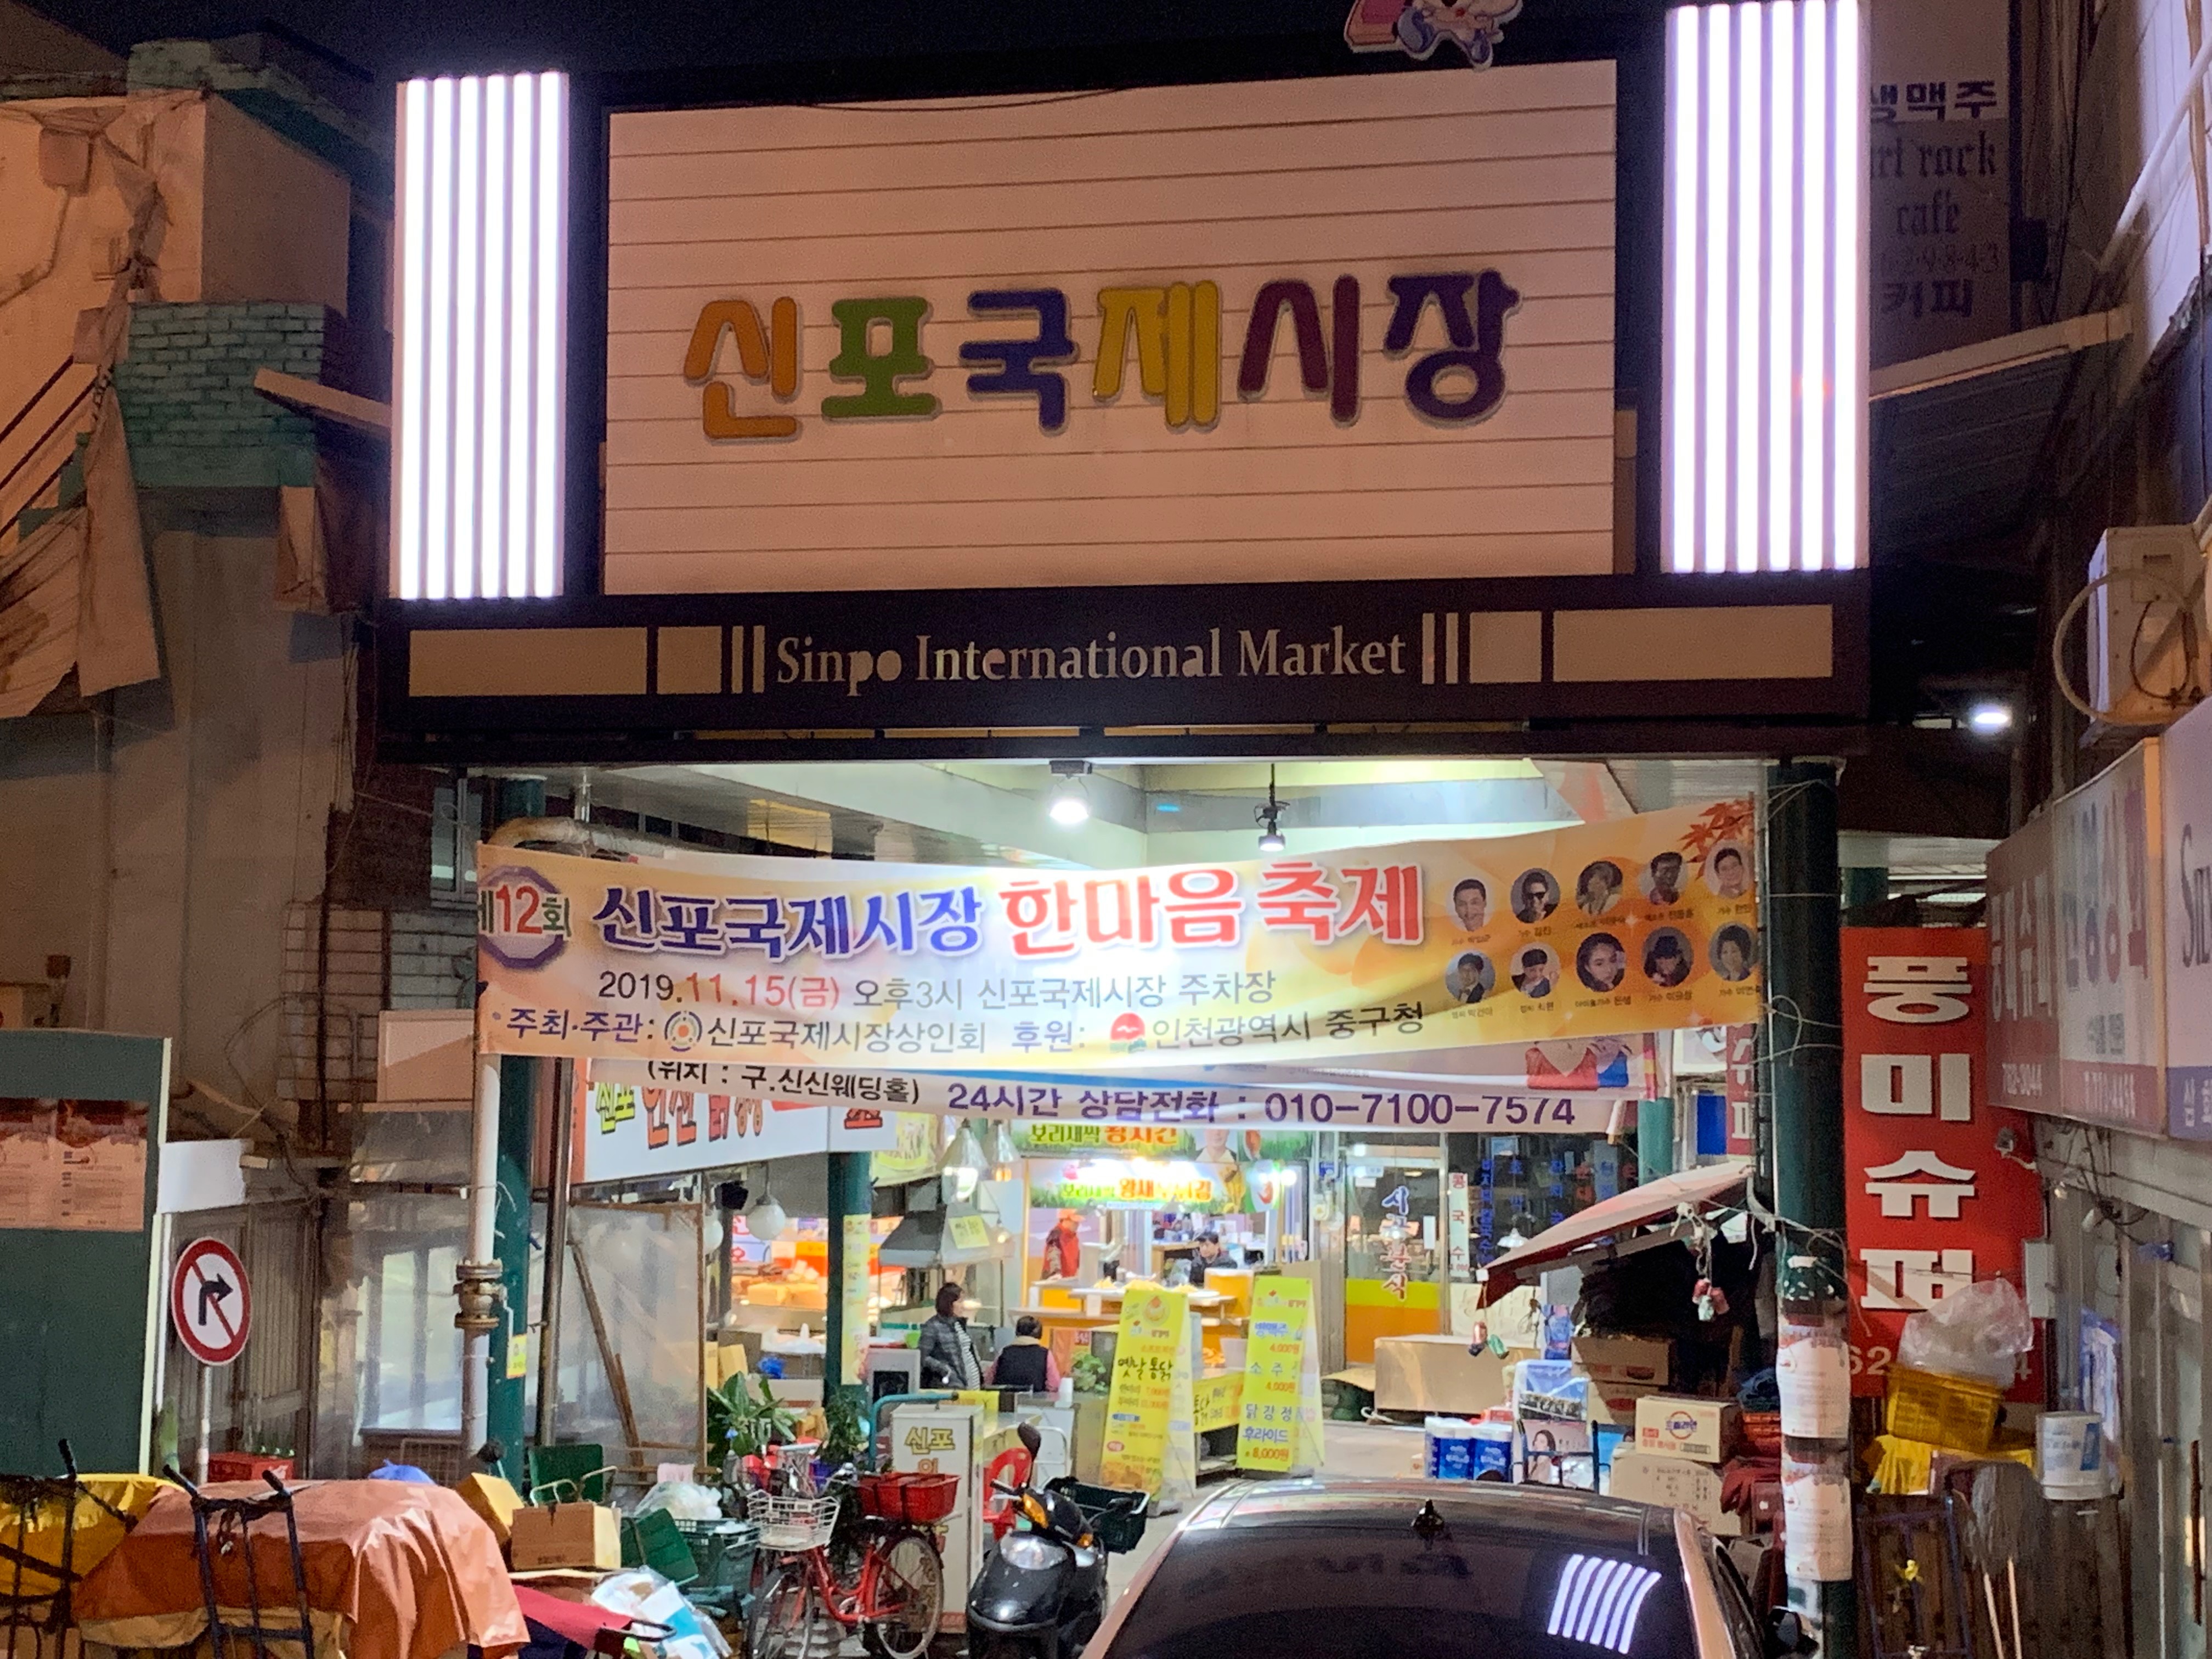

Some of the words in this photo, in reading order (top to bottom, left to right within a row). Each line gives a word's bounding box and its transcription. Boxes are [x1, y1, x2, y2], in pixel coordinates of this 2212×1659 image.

[1918, 130, 1997, 177] rock
[1881, 279, 1974, 318] 커피
[682, 269, 1522, 442] 신포국제시장
[776, 636, 902, 696] Sinpo
[916, 629, 1223, 681] International
[1237, 627, 1406, 676] Market
[592, 884, 983, 958] 신포국제시장
[854, 977, 964, 1011] 오후3시
[977, 974, 1167, 1010] 신포국제시장
[1178, 969, 1277, 1004] 주차장
[707, 1019, 986, 1053] 신포국제시장상인회
[1011, 1019, 1086, 1053] 후원:
[1152, 1011, 1312, 1050] 인천광역시
[1324, 1001, 1425, 1041] 중구청
[947, 1082, 1062, 1120] 24시간
[1078, 1089, 1220, 1124] 상담전화
[1264, 1093, 1576, 1125] 010-7100-7574
[1860, 956, 1976, 1310] 풍미슈퍼
[904, 1425, 956, 1455] 신포
